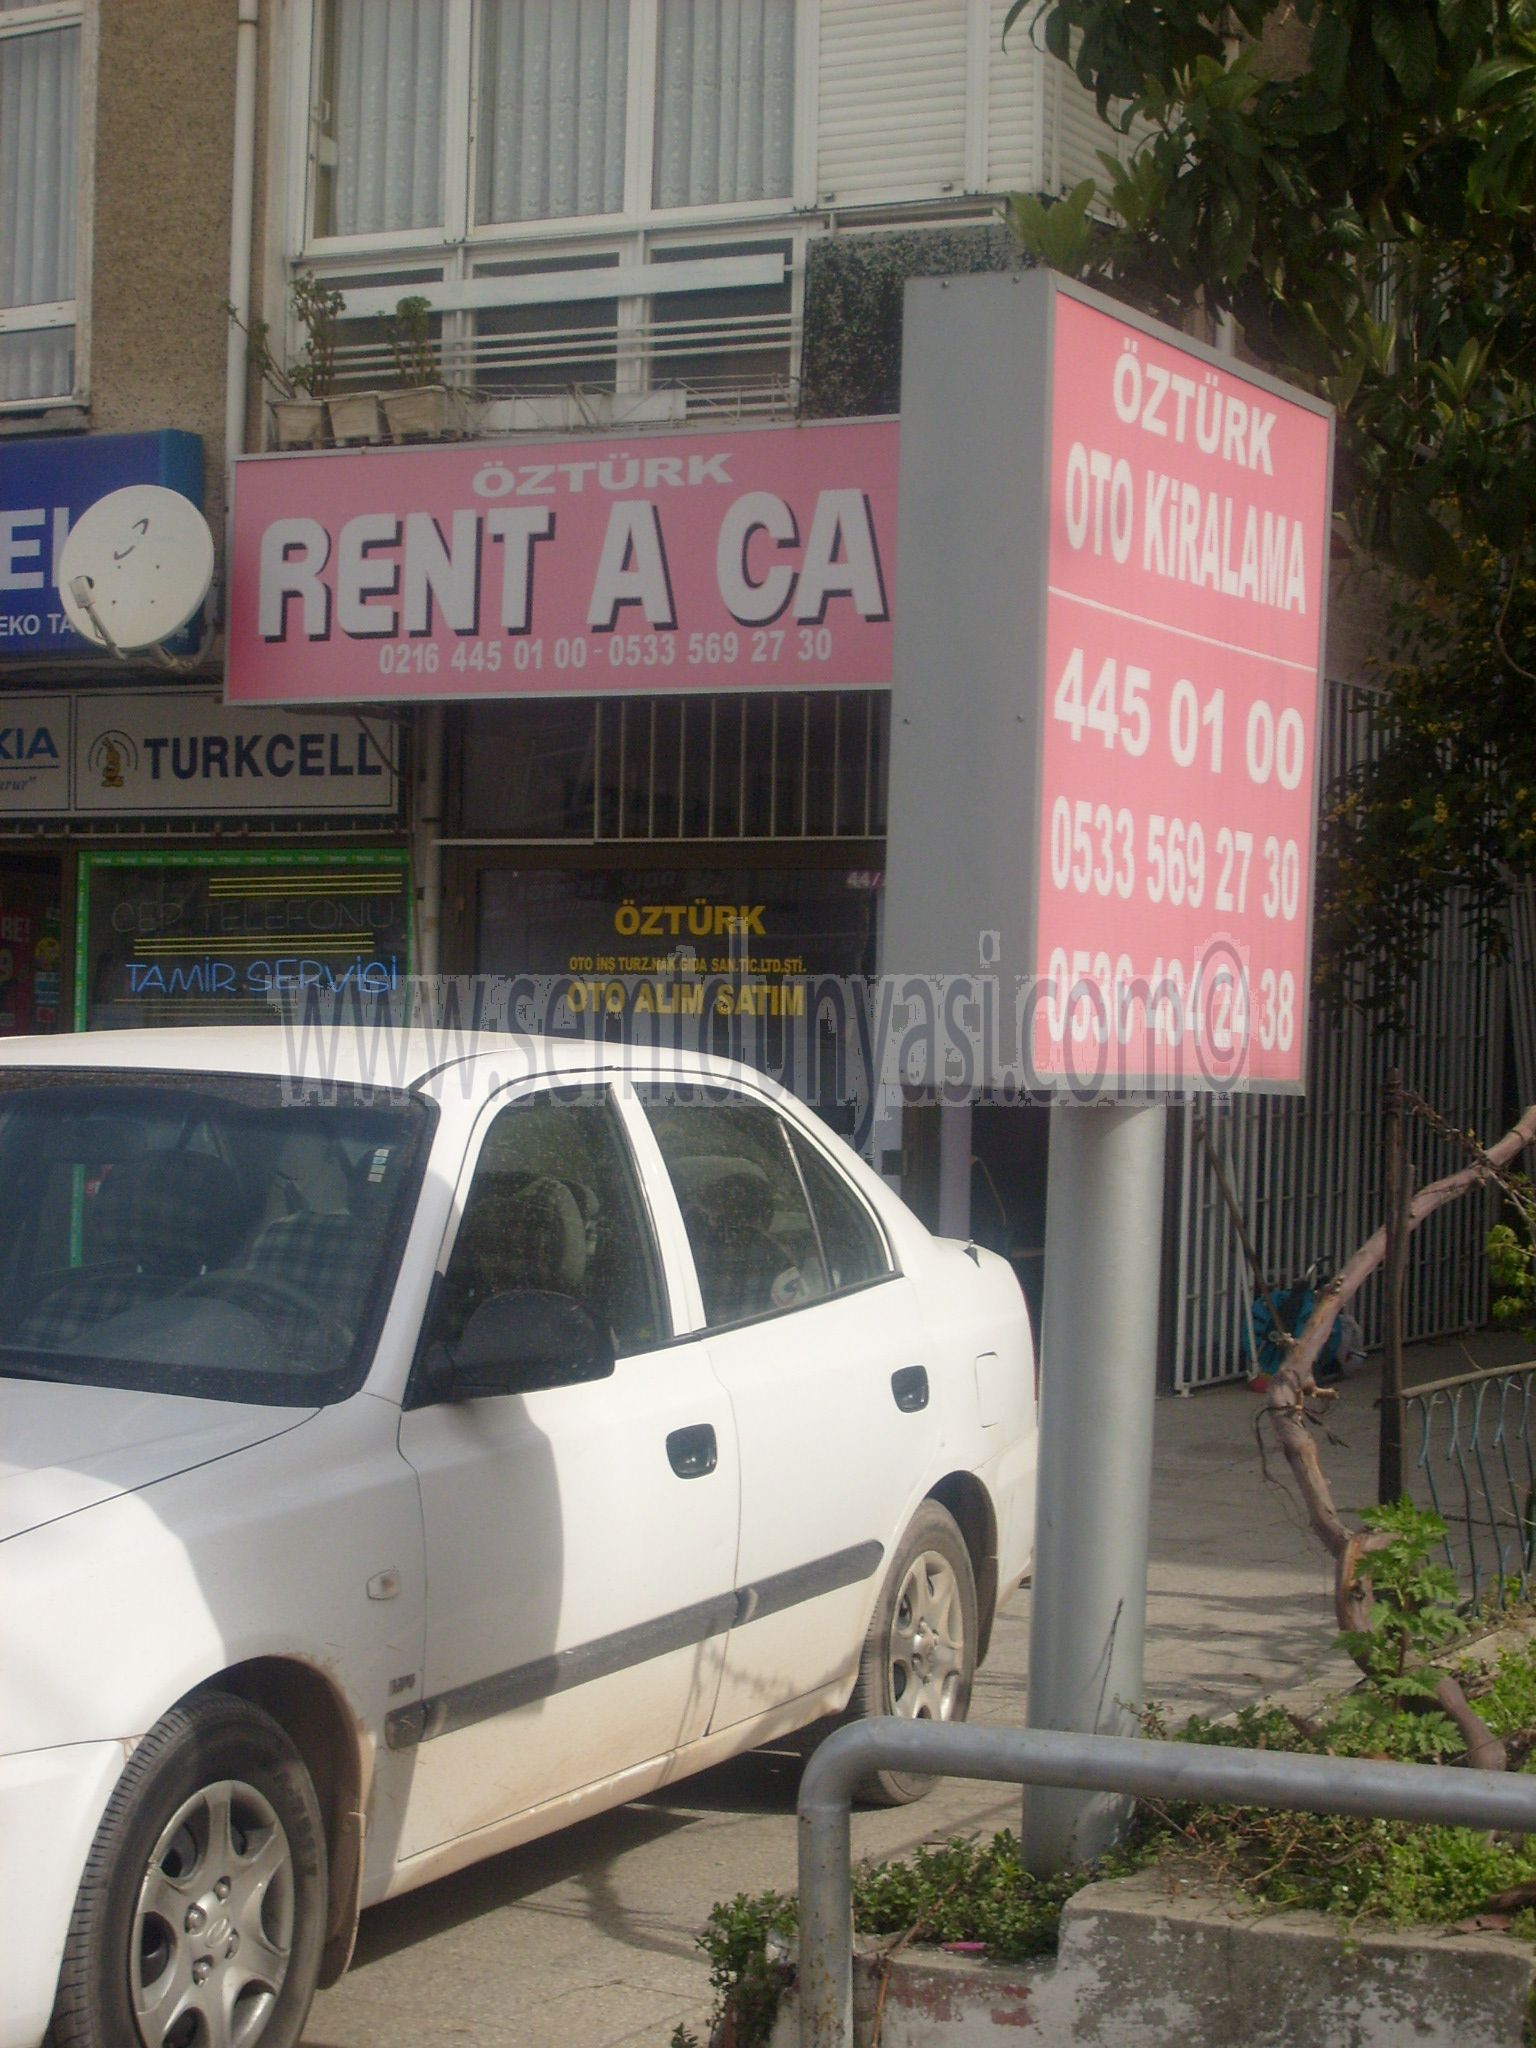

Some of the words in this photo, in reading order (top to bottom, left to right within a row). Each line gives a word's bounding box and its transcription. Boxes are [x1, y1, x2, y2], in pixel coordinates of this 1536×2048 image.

[1113, 337, 1277, 476] ÖZTÜRK
[472, 453, 734, 498] ÖZTÜRK
[1065, 441, 1133, 564] OTO
[258, 506, 555, 643] RENT
[586, 500, 678, 633] A
[379, 643, 440, 673] 0216
[451, 640, 501, 672] 445
[513, 638, 543, 670] 01
[554, 637, 588, 668] 00
[608, 633, 675, 666] 0533
[688, 631, 739, 664] 569
[751, 630, 785, 662] 27
[798, 628, 832, 661] 30
[1054, 648, 1151, 757] 445
[1169, 679, 1225, 774] 01
[1246, 700, 1305, 790] 00
[143, 732, 382, 781] TURKCELL
[1051, 796, 1135, 899] 0533
[1147, 814, 1205, 909] 569
[1215, 827, 1253, 913] 27
[1263, 836, 1299, 921] 30
[200, 900, 394, 931] TELEFONU
[614, 899, 766, 935] ÖZTÜRK
[569, 957, 593, 970] OTO
[567, 981, 627, 1014] OTO
[634, 983, 705, 1014] ALIM
[716, 984, 804, 1016] SATIM
[1213, 964, 1249, 1049] 24
[1259, 968, 1295, 1051] 38
